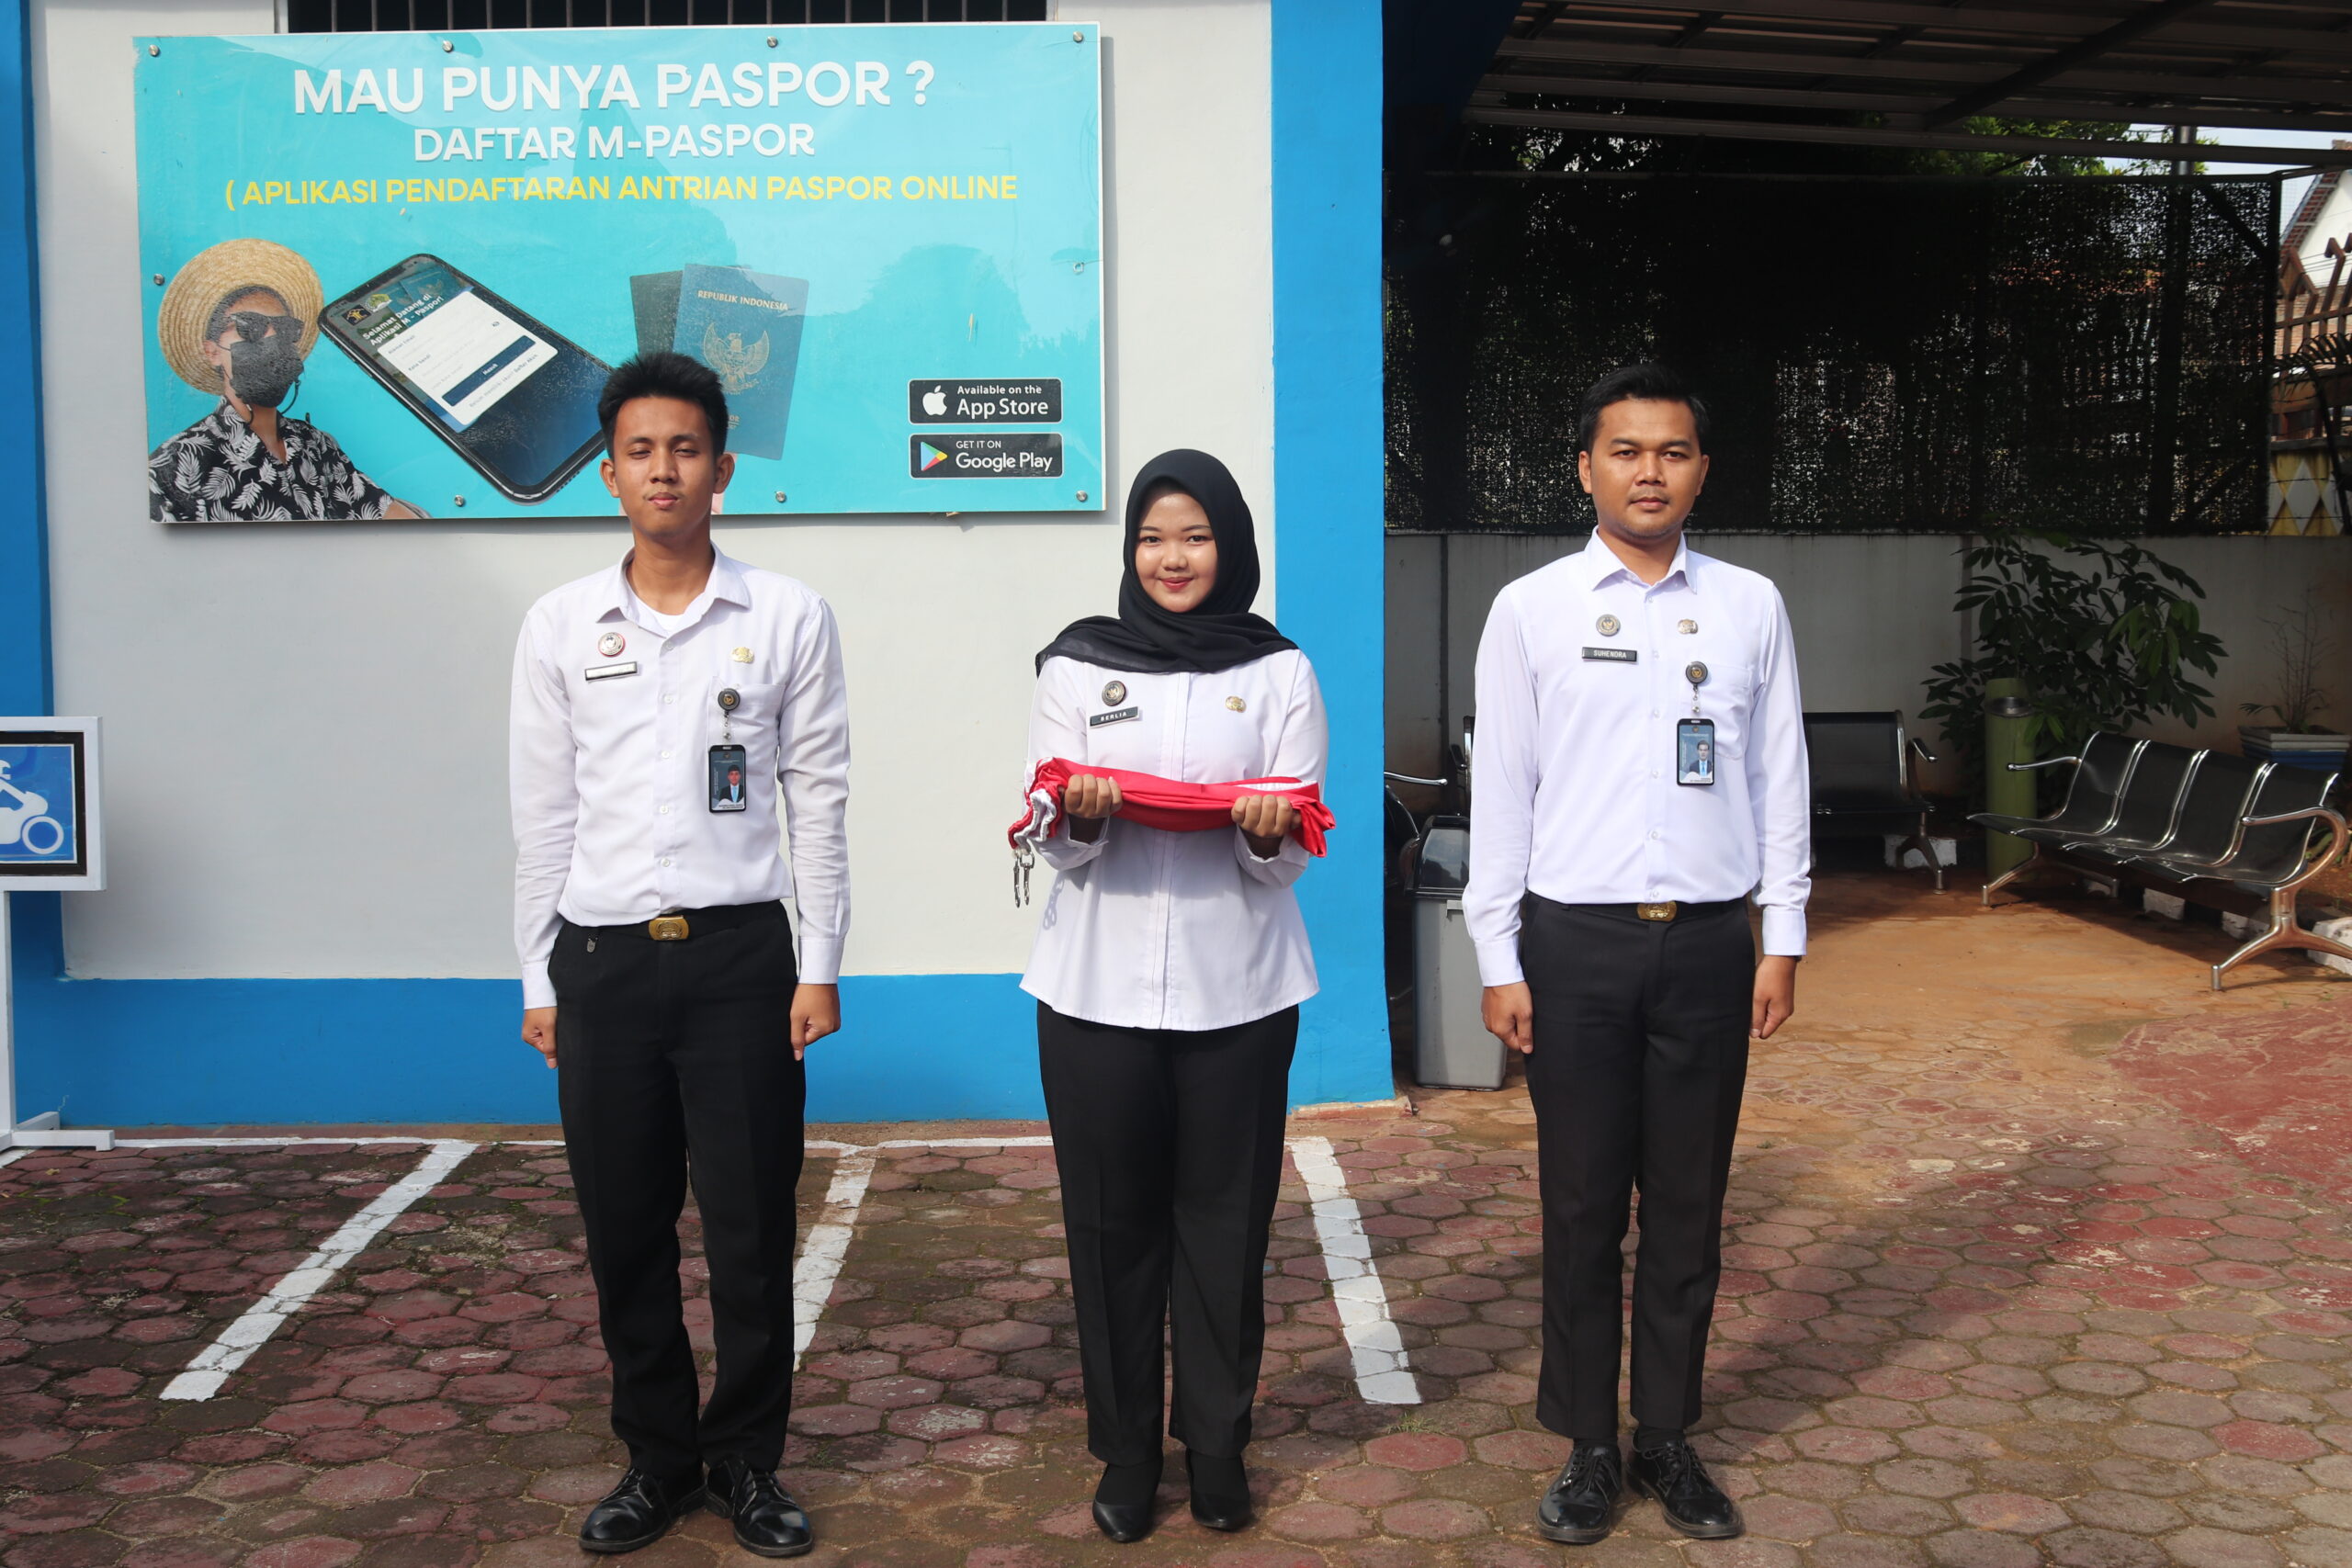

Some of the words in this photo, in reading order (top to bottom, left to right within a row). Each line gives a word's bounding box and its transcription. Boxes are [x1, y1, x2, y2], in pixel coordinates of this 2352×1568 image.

[295, 68, 424, 114] MAU
[443, 65, 640, 111] PUNYA
[657, 62, 891, 108] PASPOR
[905, 61, 935, 106] ?
[414, 127, 576, 162] DAFTAR
[588, 123, 816, 159] M-PASPOR
[243, 179, 378, 205] APLIKASI
[387, 175, 610, 203] PENDAFTARAN
[618, 175, 758, 201] ANTRIAN
[767, 175, 893, 200] PASPOR
[900, 175, 1018, 200] ONLINE
[698, 290, 738, 303] REPUBLIK
[741, 297, 788, 310] INDONESIA
[362, 317, 398, 340] Selamat
[395, 299, 424, 320] Datang
[423, 293, 433, 301] di
[370, 322, 403, 346] Aplikasi
[956, 385, 1006, 395] Available
[1008, 387, 1023, 395] on
[1024, 385, 1043, 395] the
[956, 399, 996, 420] App
[999, 398, 1049, 415] Store
[956, 441, 975, 449] GET
[976, 440, 986, 449] IT
[987, 440, 1002, 449] ON
[956, 452, 1016, 473] Google
[1019, 452, 1054, 472] Play
[1593, 649, 1627, 659] SUHENDRA
[1101, 711, 1127, 721] BERLIA
